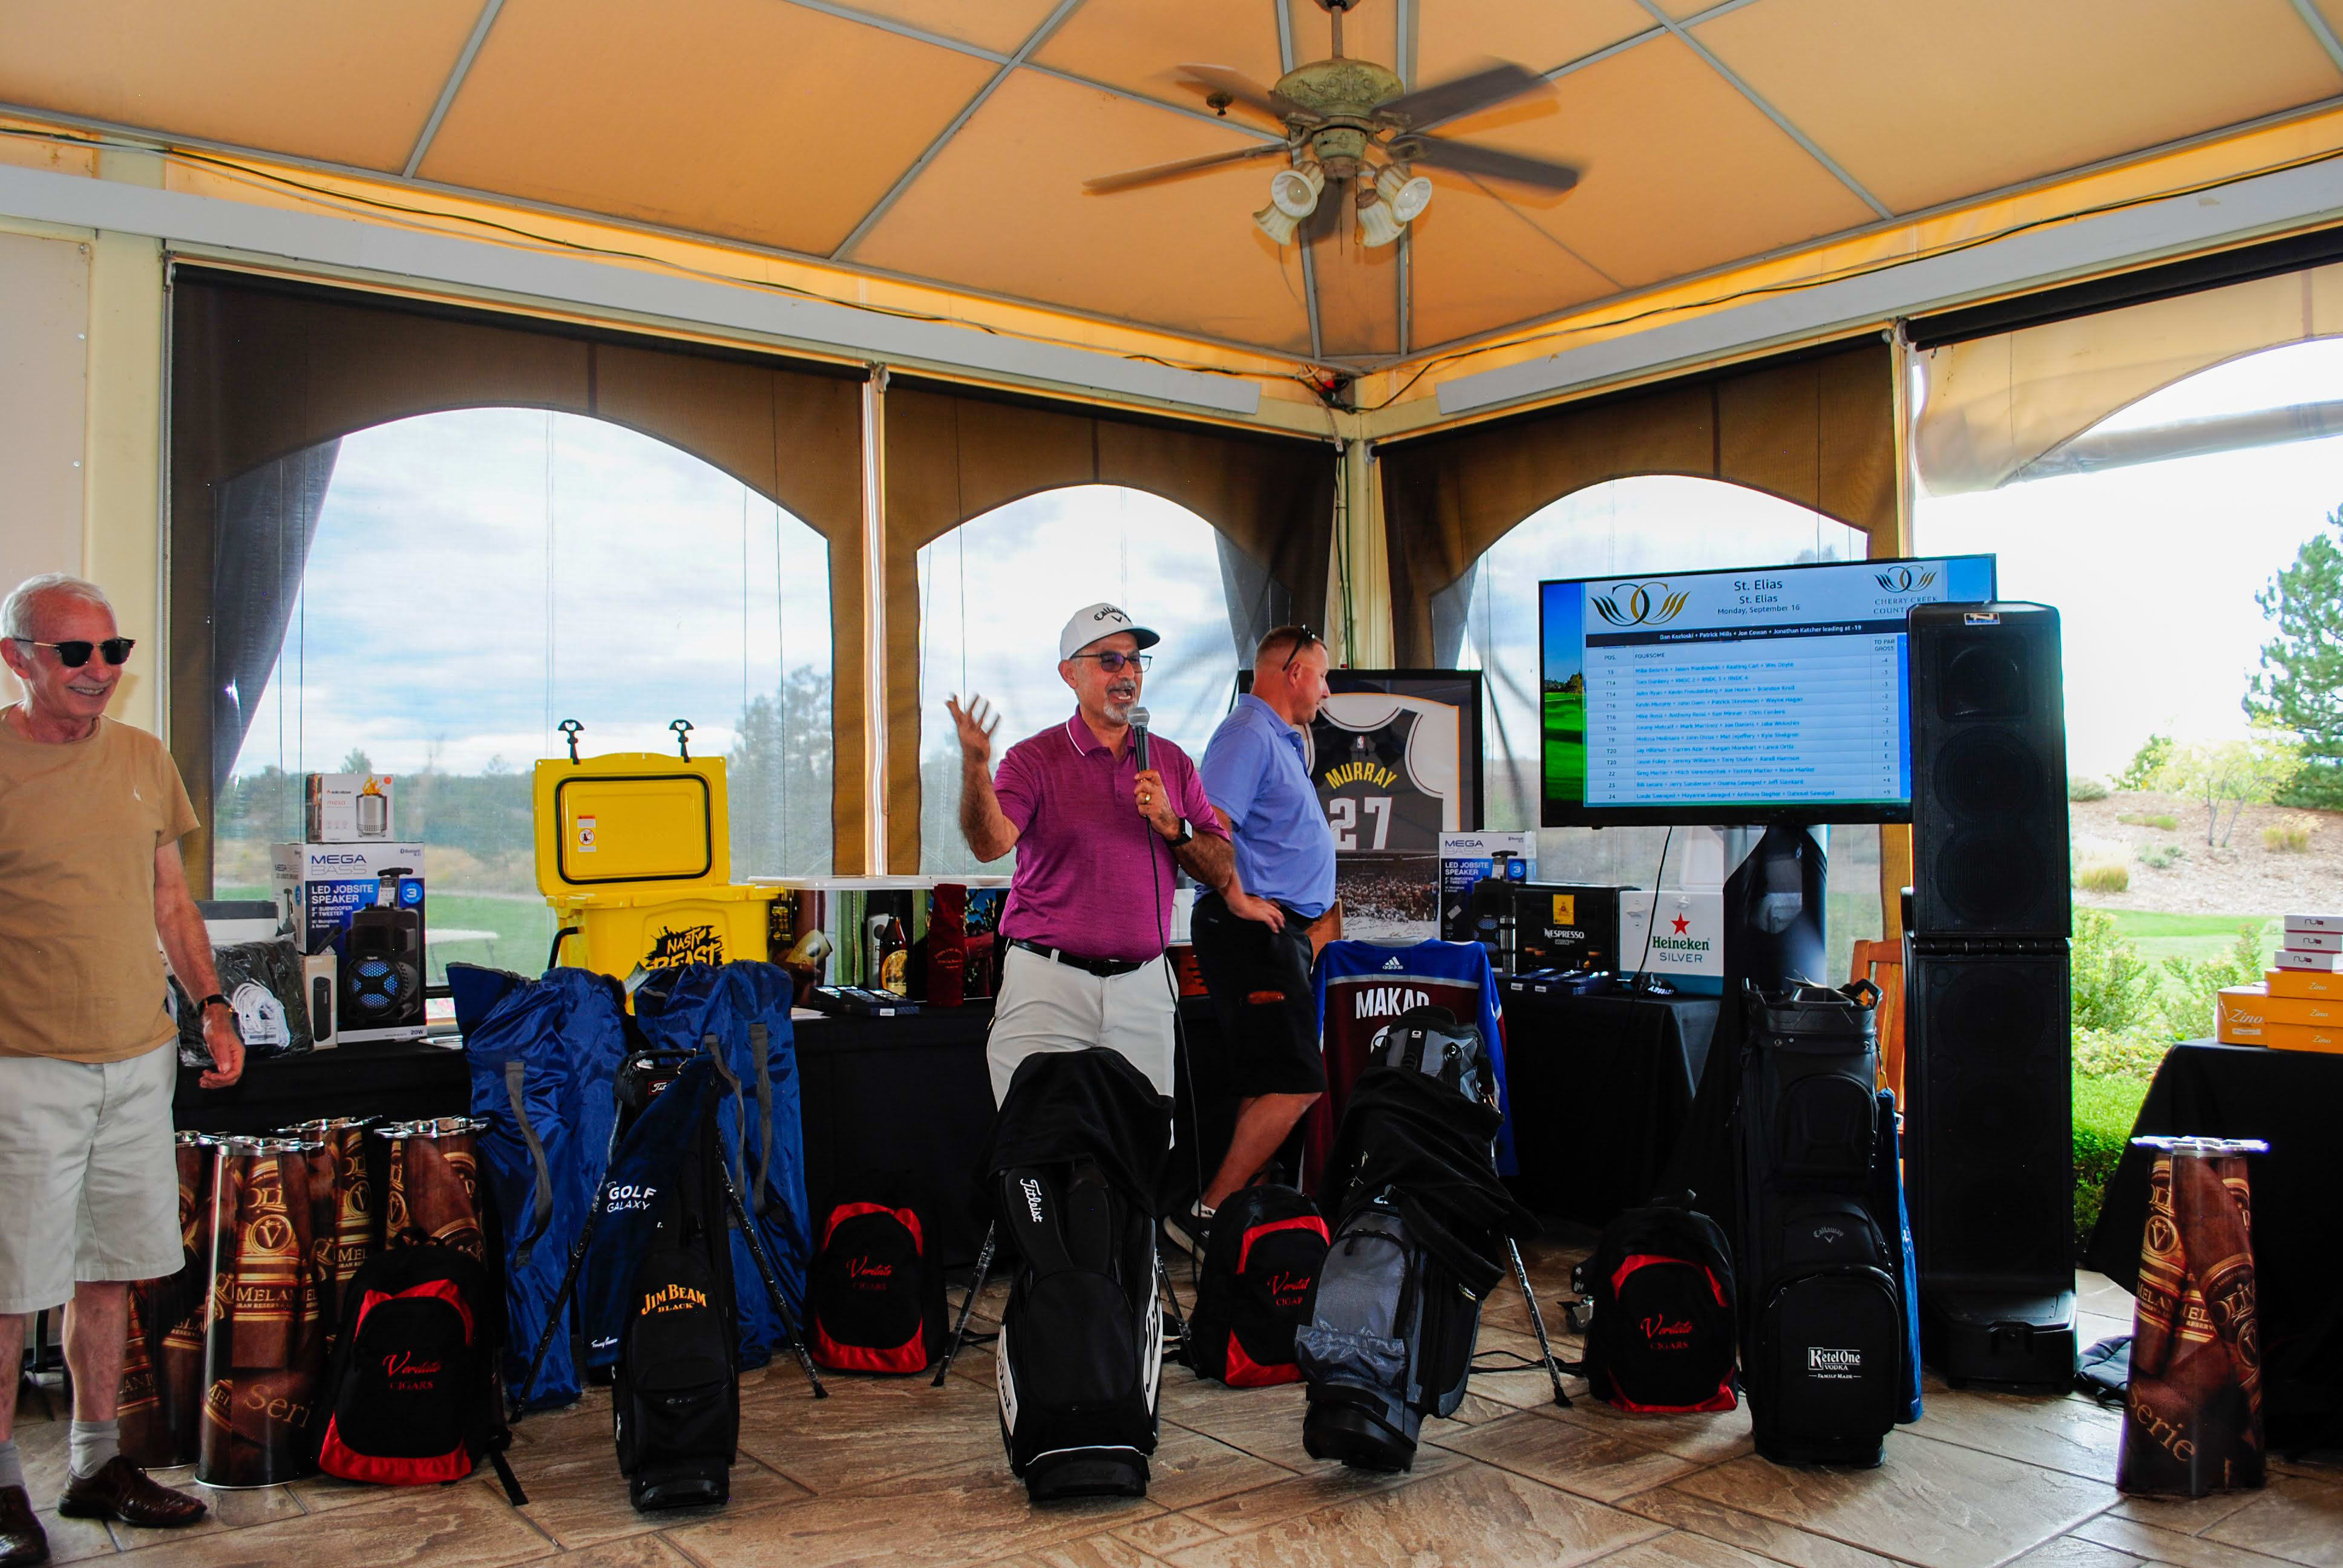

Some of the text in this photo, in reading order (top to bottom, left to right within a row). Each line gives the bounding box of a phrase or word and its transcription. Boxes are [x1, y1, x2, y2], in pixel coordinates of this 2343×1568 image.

[1734, 580, 1783, 591] St. Elias
[1755, 594, 1778, 603] Elias
[1875, 595, 1938, 606] CHERRY CREEK
[1750, 605, 1788, 614] September
[1325, 762, 1398, 789] MURRAY
[1329, 797, 1392, 850] 27
[312, 855, 367, 864] MEGA
[312, 864, 367, 875] BASS
[312, 884, 373, 894] LED JOBSITE
[406, 888, 417, 898] 3
[312, 895, 359, 904] SPEAKER
[1544, 928, 1585, 939] NESPRESSO
[667, 927, 707, 955] NASTY
[1653, 936, 1709, 950] Heineken
[1660, 952, 1703, 963] SILVER
[2227, 1008, 2264, 1024] Zino
[2312, 1035, 2331, 1044] Zino
[609, 1185, 657, 1200] GOLF
[1020, 1178, 1043, 1222] Titleist
[607, 1200, 650, 1213] GALAXY
[260, 1225, 283, 1248] V
[641, 1284, 707, 1316] JIM BEAM
[658, 1302, 693, 1313] BLACK
[1810, 1350, 1860, 1368] Ketel One
[2130, 1383, 2195, 1462] Serie
